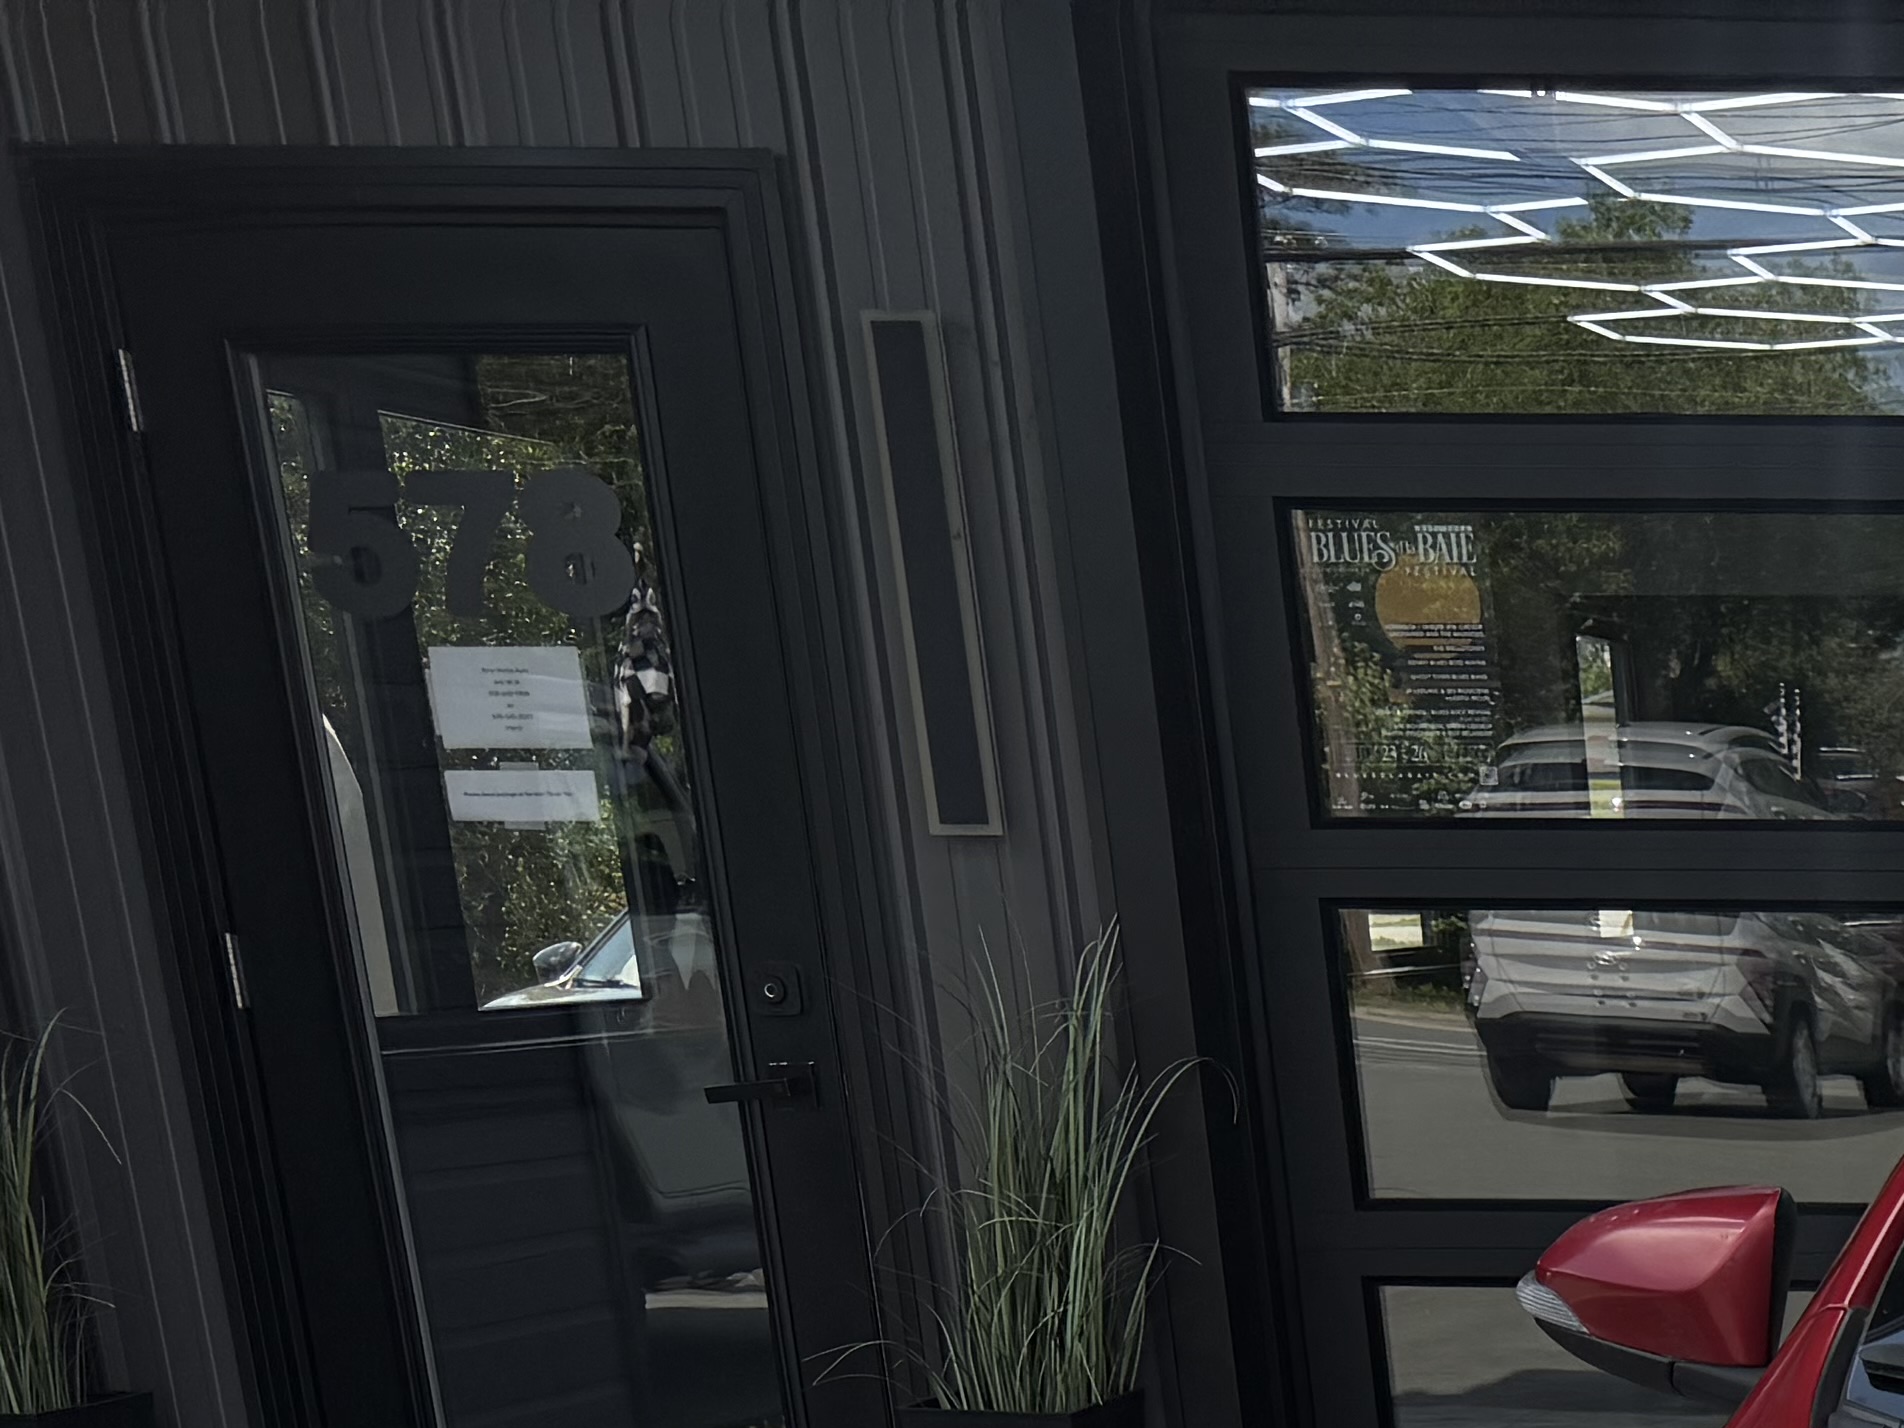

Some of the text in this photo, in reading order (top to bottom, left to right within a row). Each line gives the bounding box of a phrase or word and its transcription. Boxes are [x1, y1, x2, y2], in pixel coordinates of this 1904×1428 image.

[1308, 518, 1378, 529] FESTIVAL
[307, 468, 636, 621] 578
[1310, 531, 1396, 571] BLUES
[1416, 531, 1477, 564] BAIE
[1405, 566, 1477, 577] FESTIVAL
